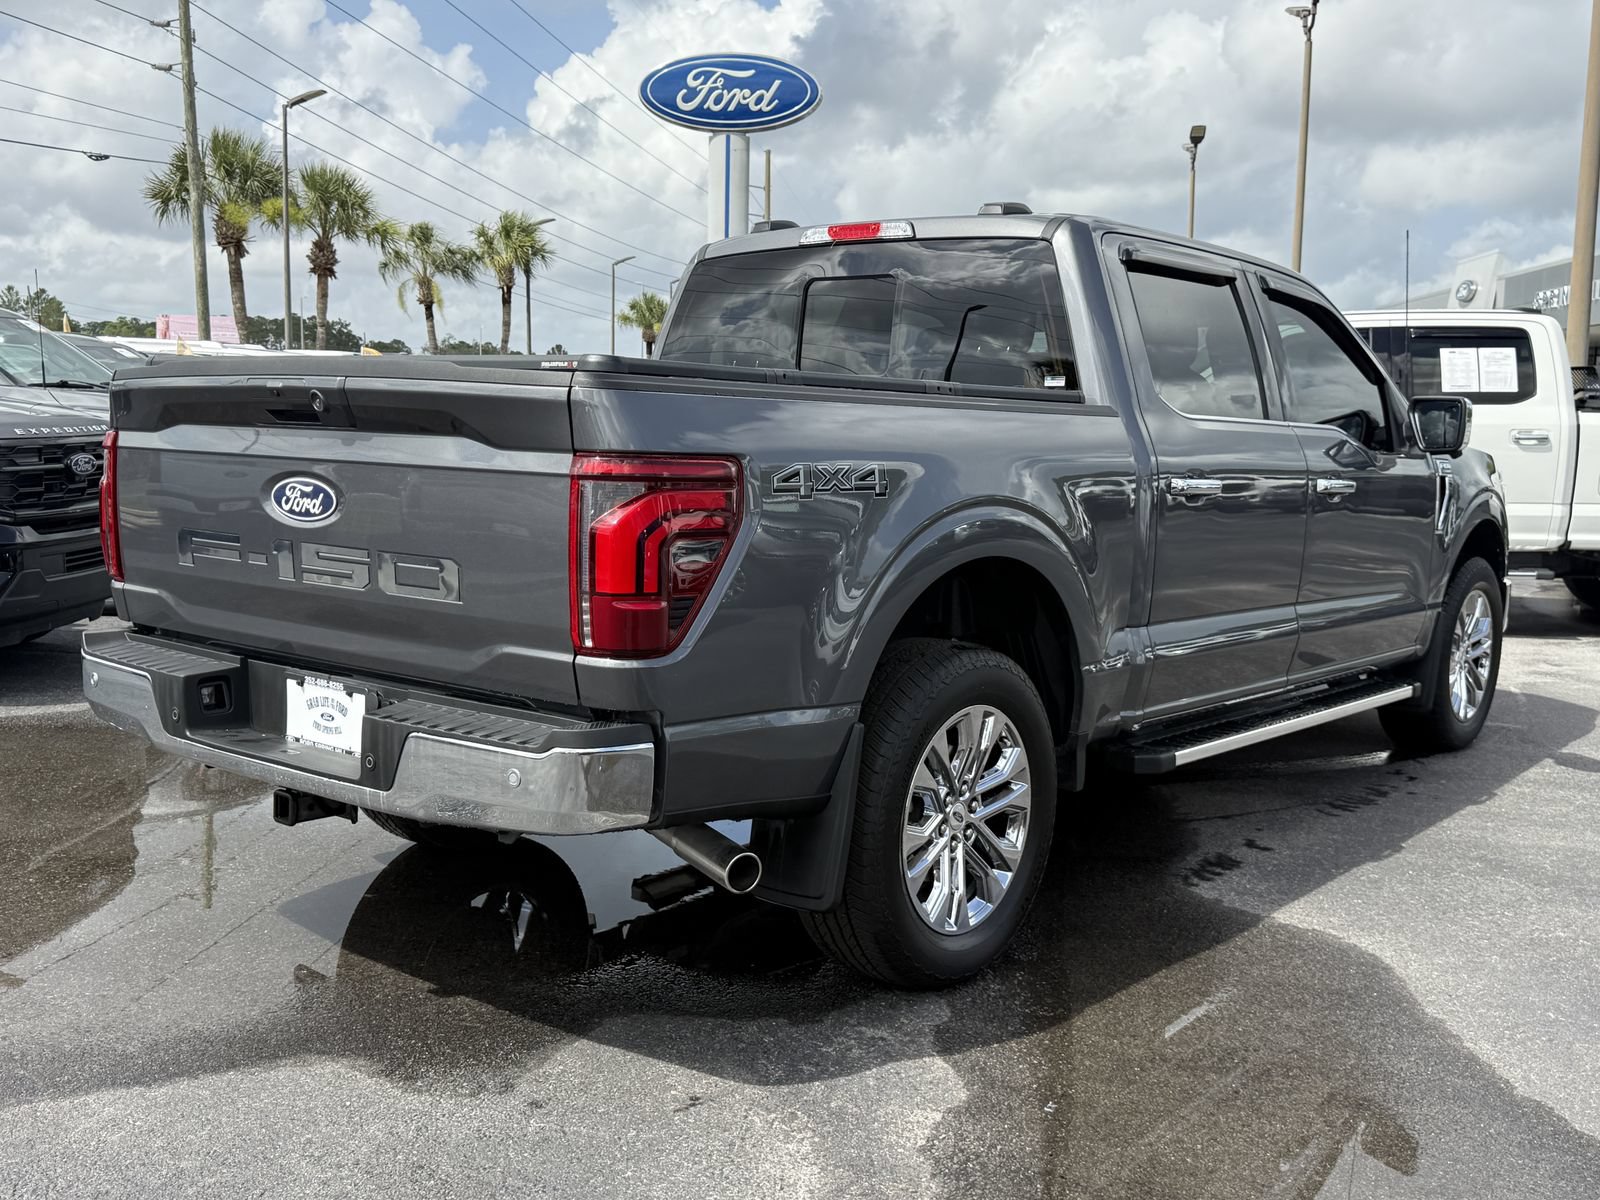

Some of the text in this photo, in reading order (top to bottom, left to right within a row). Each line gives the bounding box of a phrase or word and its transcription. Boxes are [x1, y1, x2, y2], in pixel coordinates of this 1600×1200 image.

[676, 67, 782, 112] Ford
[13, 424, 109, 435] EXPEDITION
[281, 482, 324, 515] Ford
[178, 527, 463, 605] F-150
